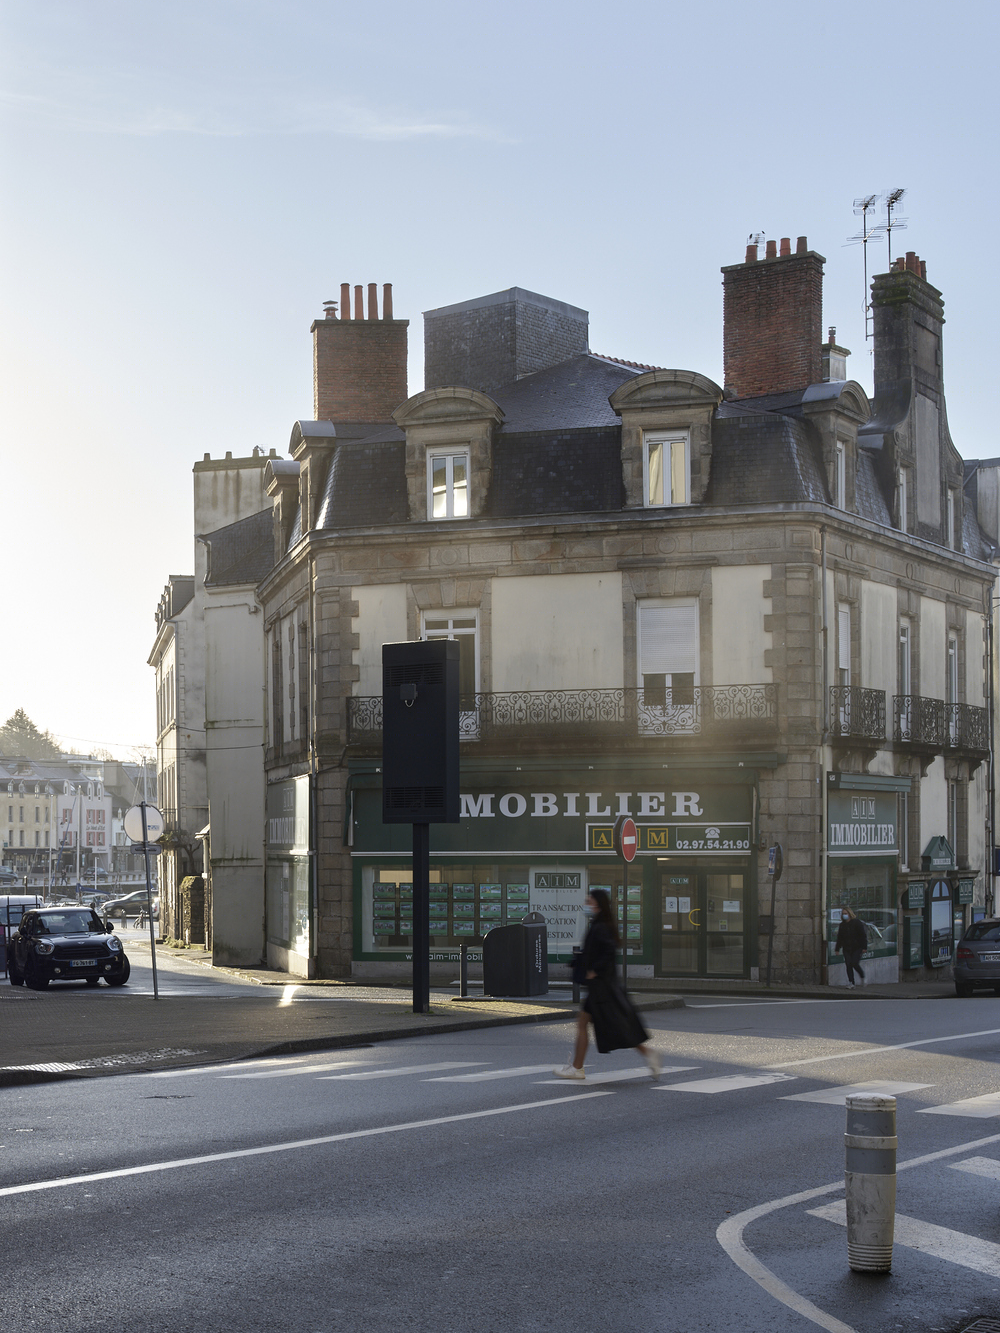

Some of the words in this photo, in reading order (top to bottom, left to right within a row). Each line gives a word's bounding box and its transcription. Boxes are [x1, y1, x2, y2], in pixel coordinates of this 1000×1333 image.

[459, 792, 703, 817] MOBILIER
[852, 799, 875, 816] AIM
[831, 823, 895, 845] IMMOBILIER
[676, 840, 750, 850] 02.97.54.21.90
[537, 875, 578, 887] AIM
[532, 904, 584, 912] TRANSACTION
